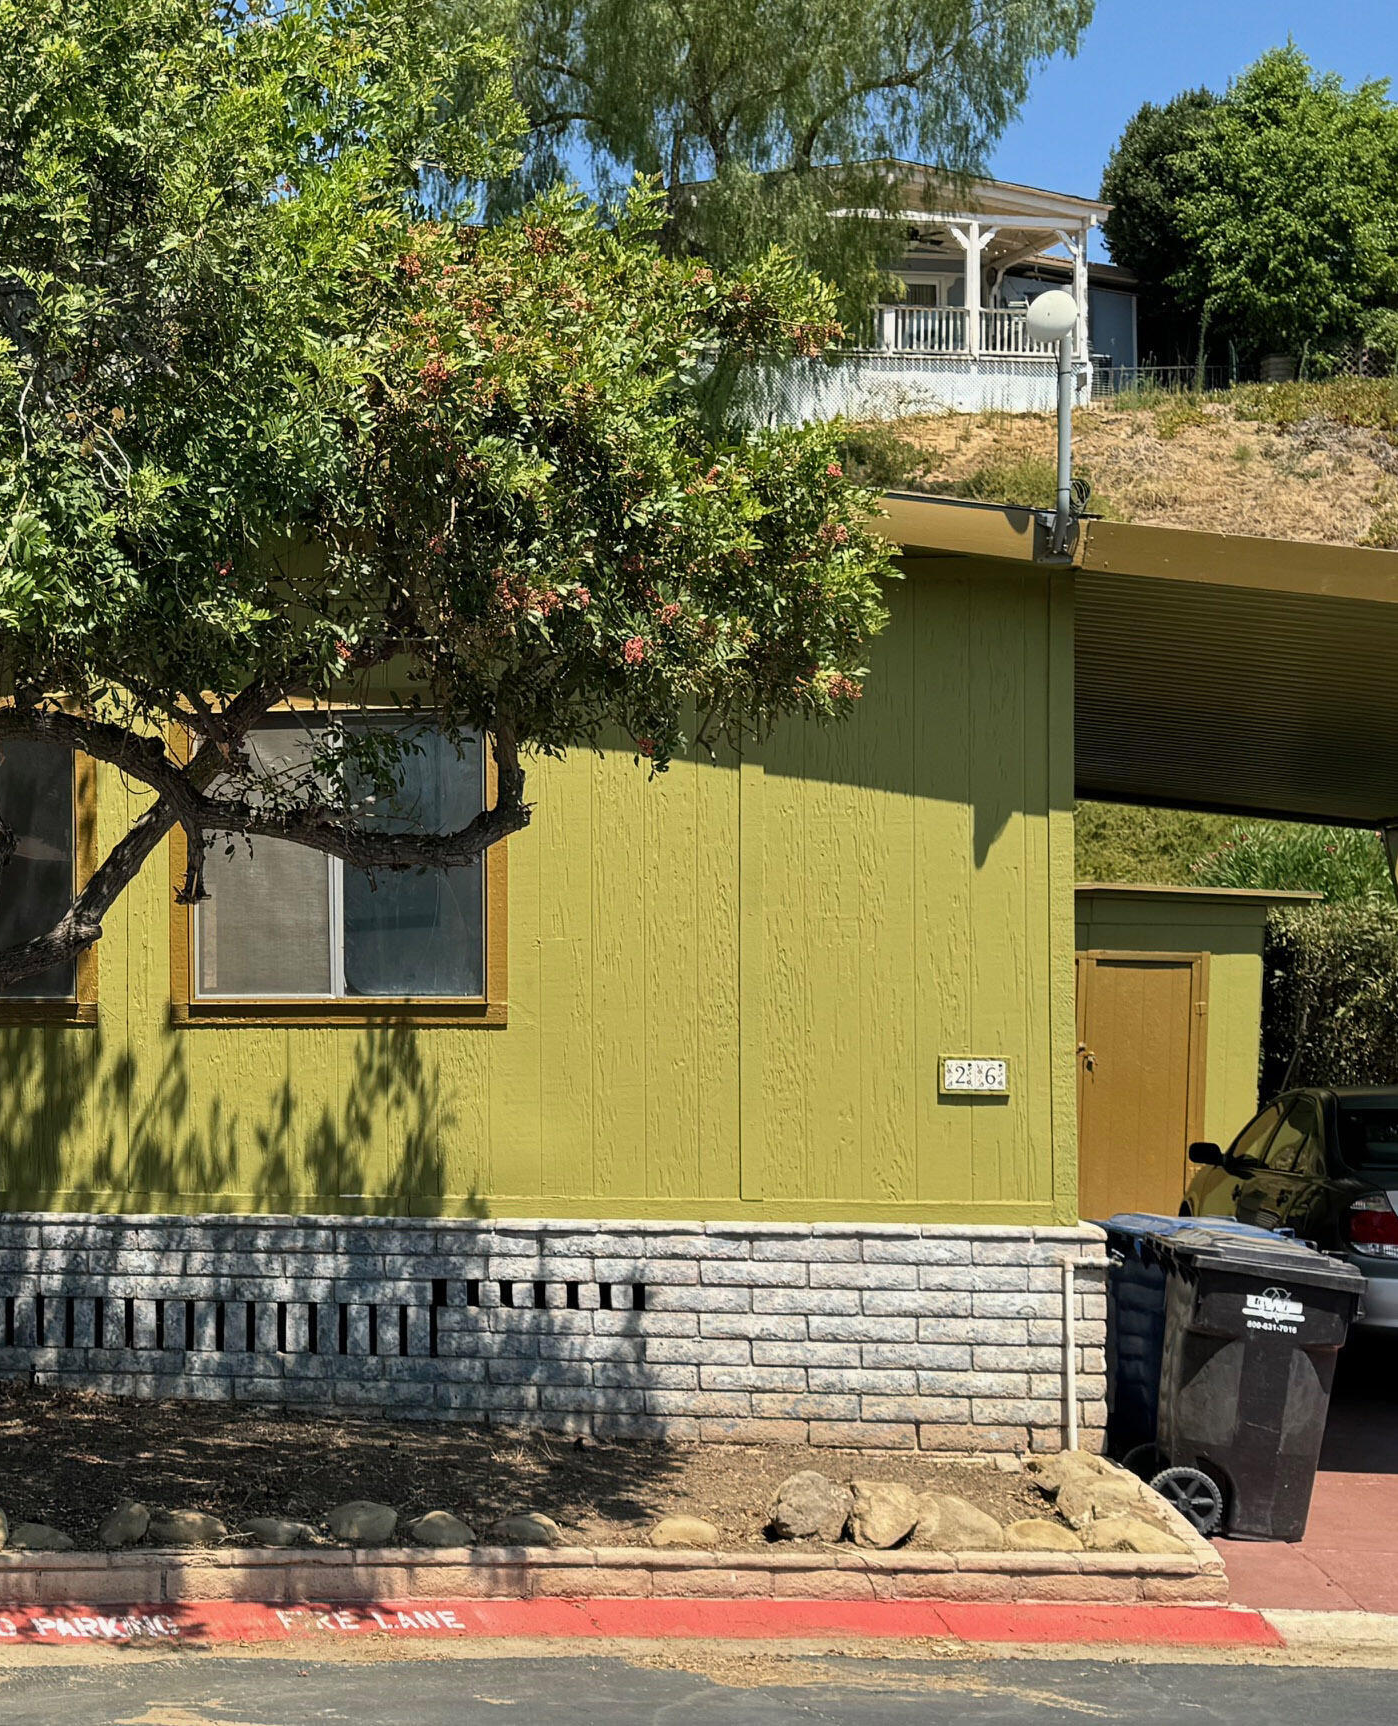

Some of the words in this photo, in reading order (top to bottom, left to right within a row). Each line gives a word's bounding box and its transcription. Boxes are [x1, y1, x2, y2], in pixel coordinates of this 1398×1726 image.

[954, 1065, 997, 1086] 26
[32, 1615, 180, 1638] PARKING
[370, 1610, 466, 1630] LANE
